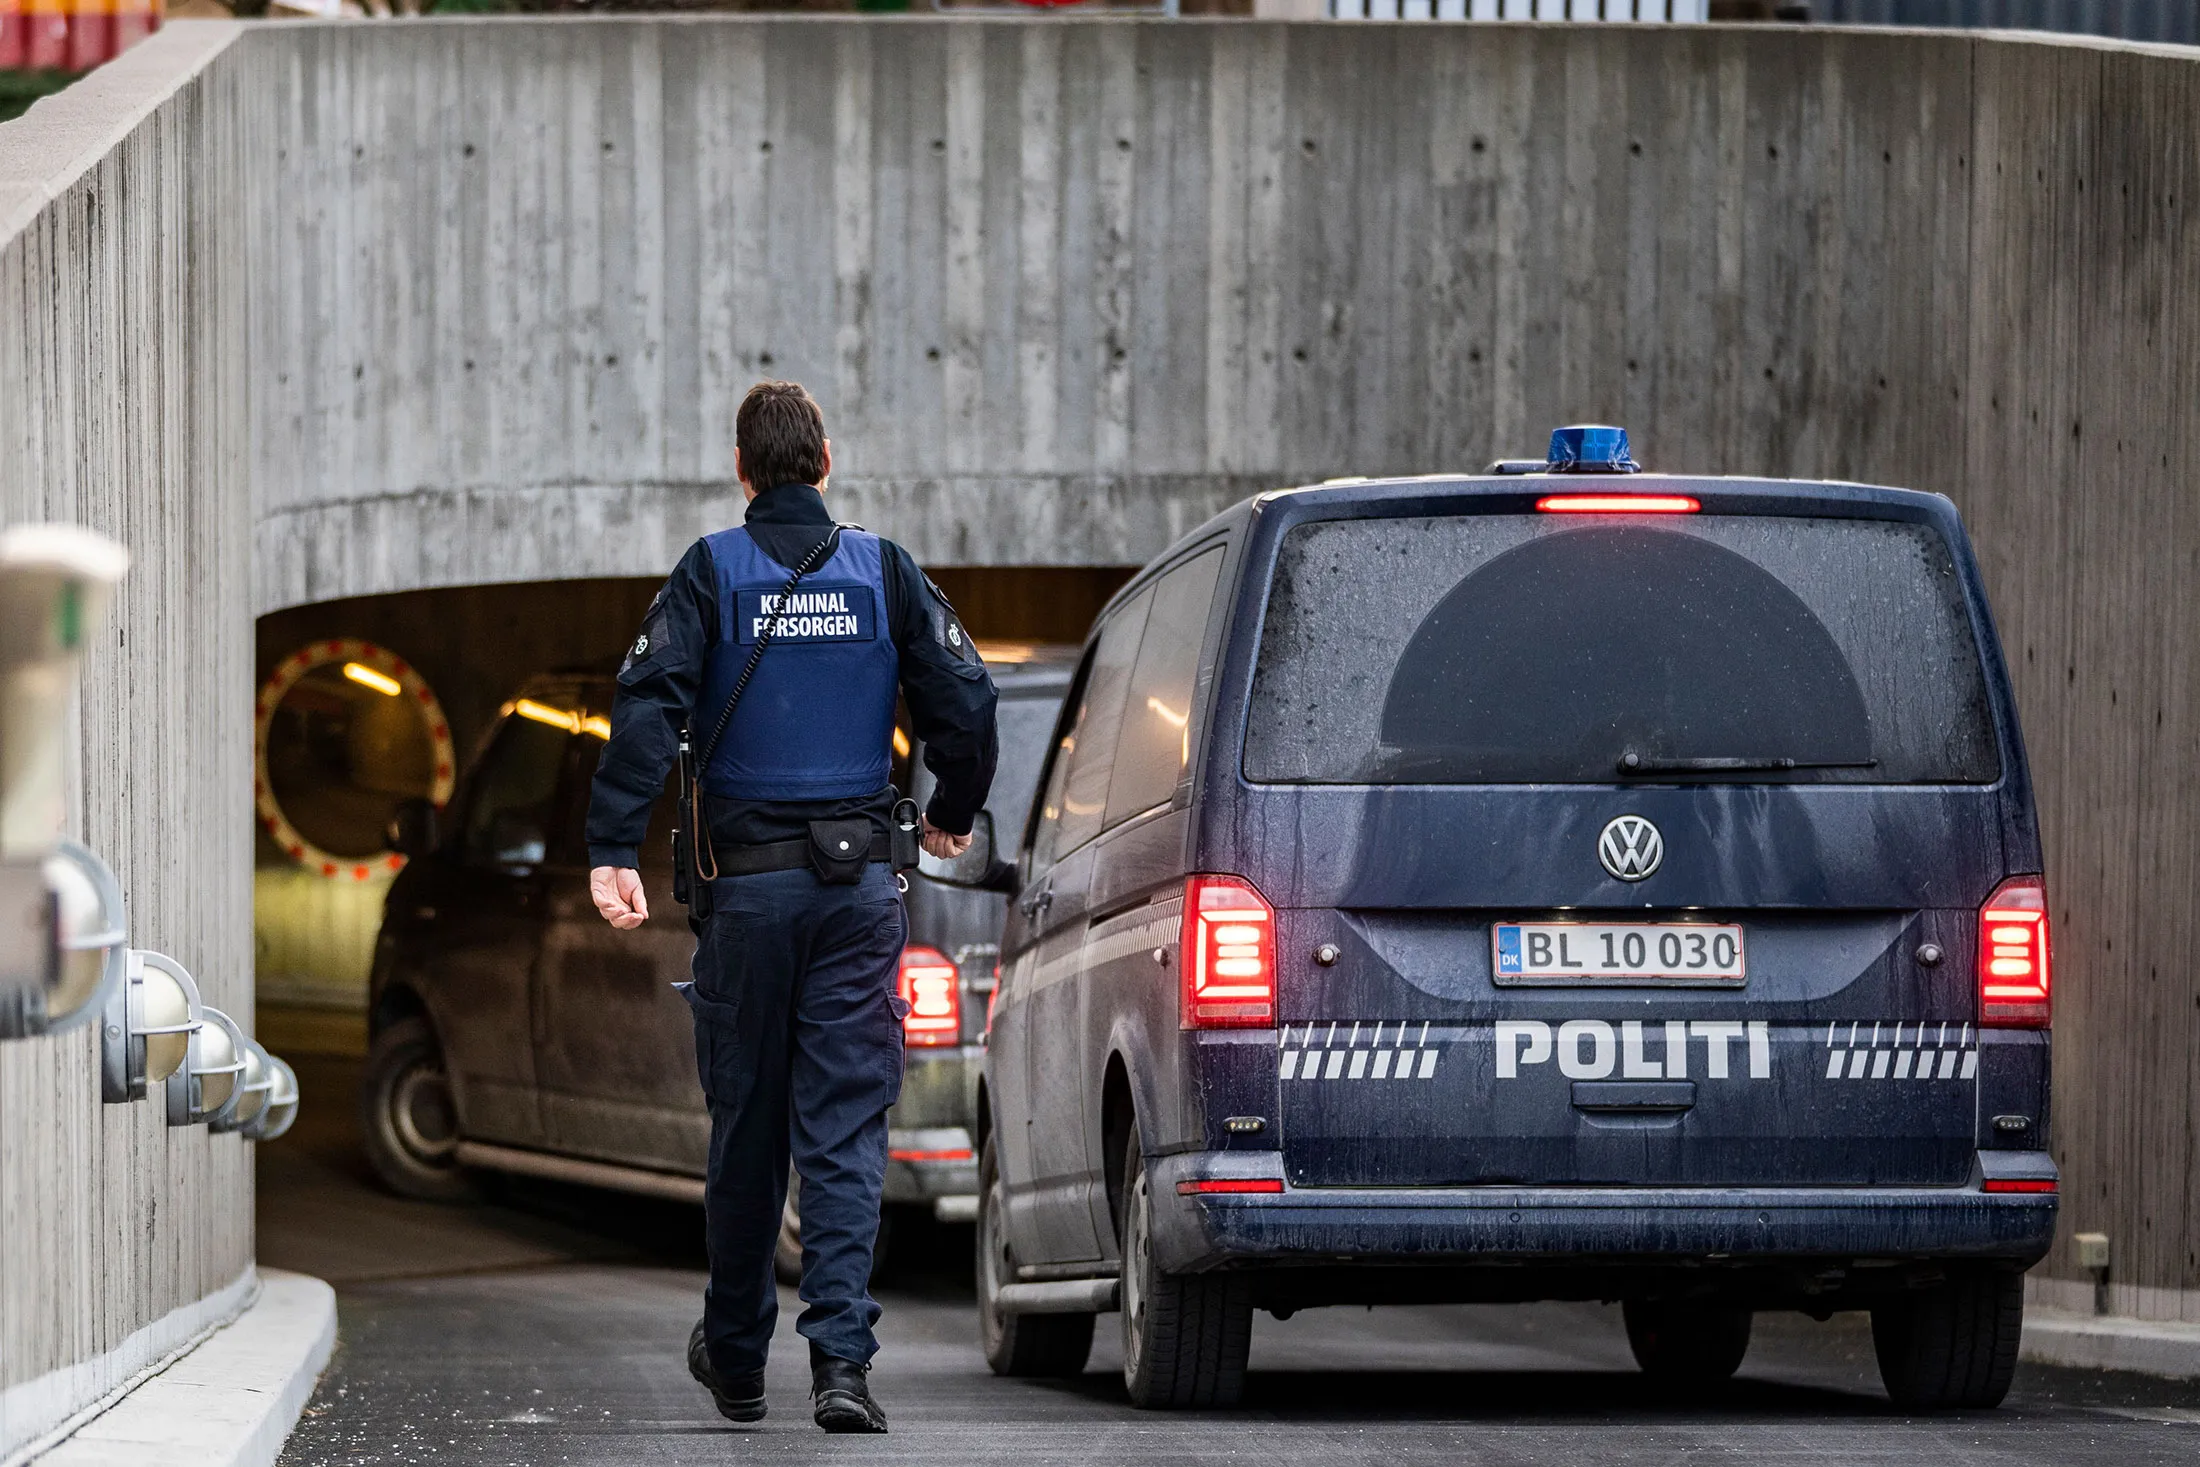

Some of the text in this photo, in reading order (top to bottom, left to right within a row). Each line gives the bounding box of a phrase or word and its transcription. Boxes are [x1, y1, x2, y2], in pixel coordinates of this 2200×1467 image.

[752, 615, 857, 637] FORSORGEN
[1502, 954, 1519, 966] DK
[1527, 932, 1736, 969] BL 10 030
[1495, 1019, 1770, 1079] POLITI
